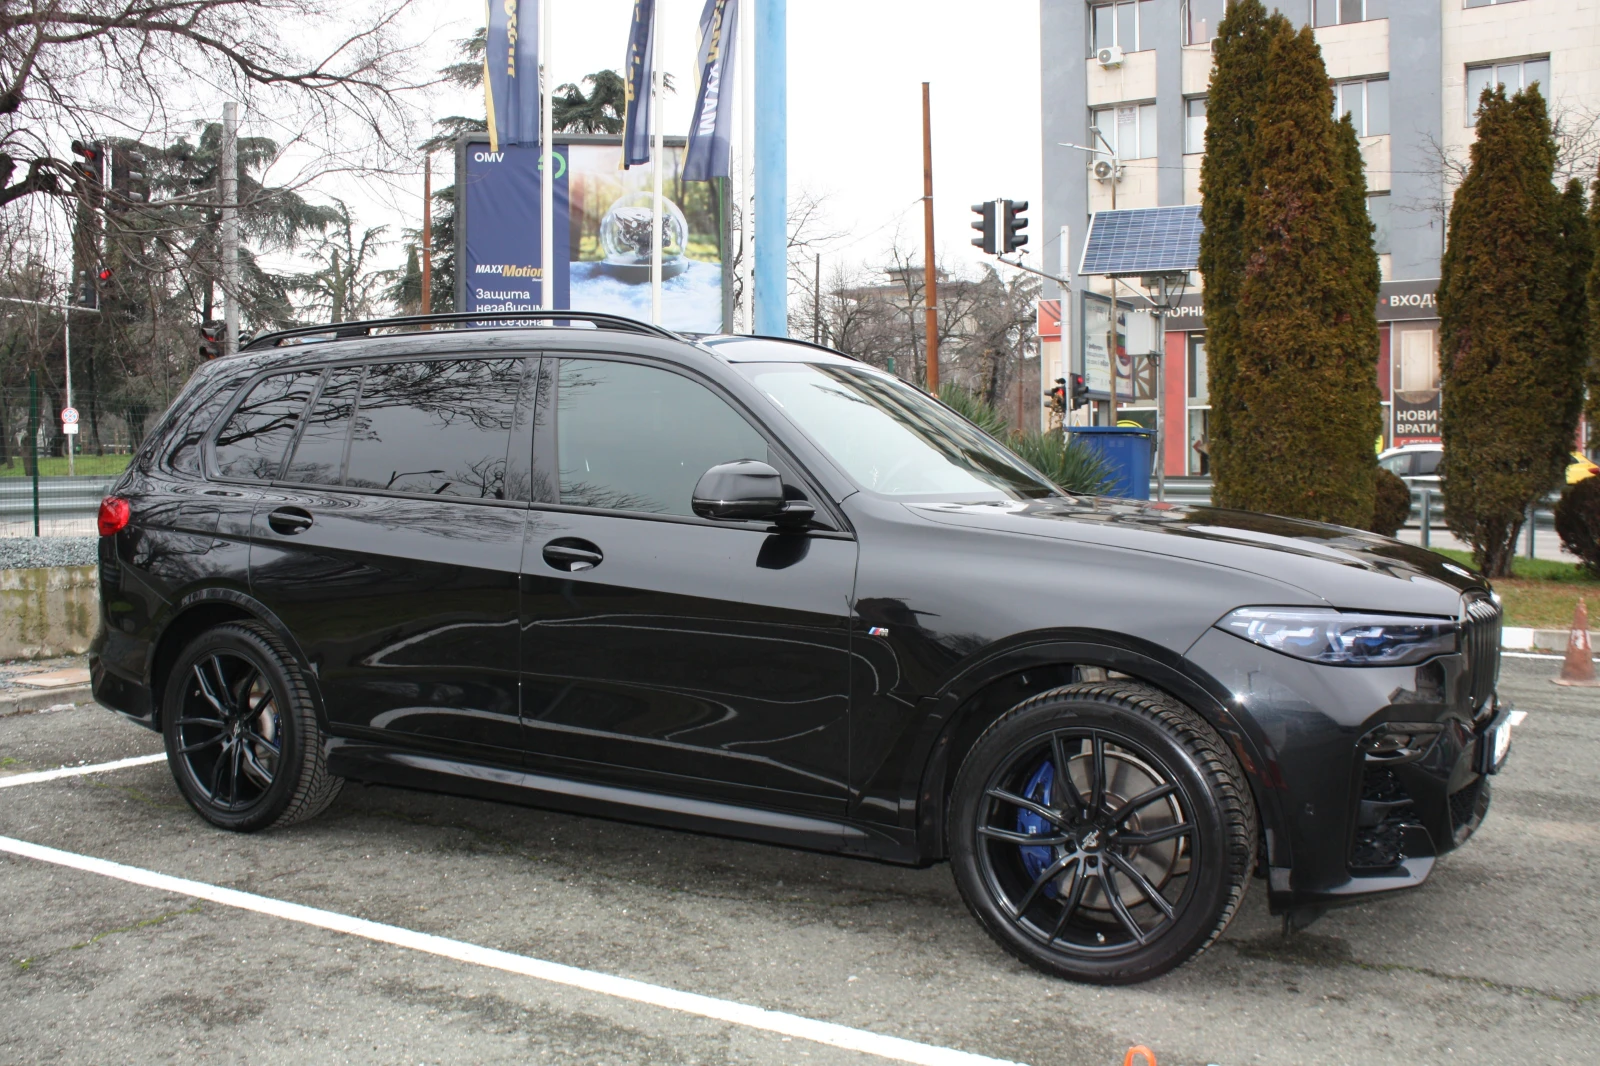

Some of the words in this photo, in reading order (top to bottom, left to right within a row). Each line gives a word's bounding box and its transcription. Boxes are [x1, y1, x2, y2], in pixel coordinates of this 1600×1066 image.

[474, 152, 505, 163] OMV
[475, 288, 531, 300] Защита
[1396, 410, 1438, 421] НОВИ
[1396, 423, 1438, 434] ВРАТИ
